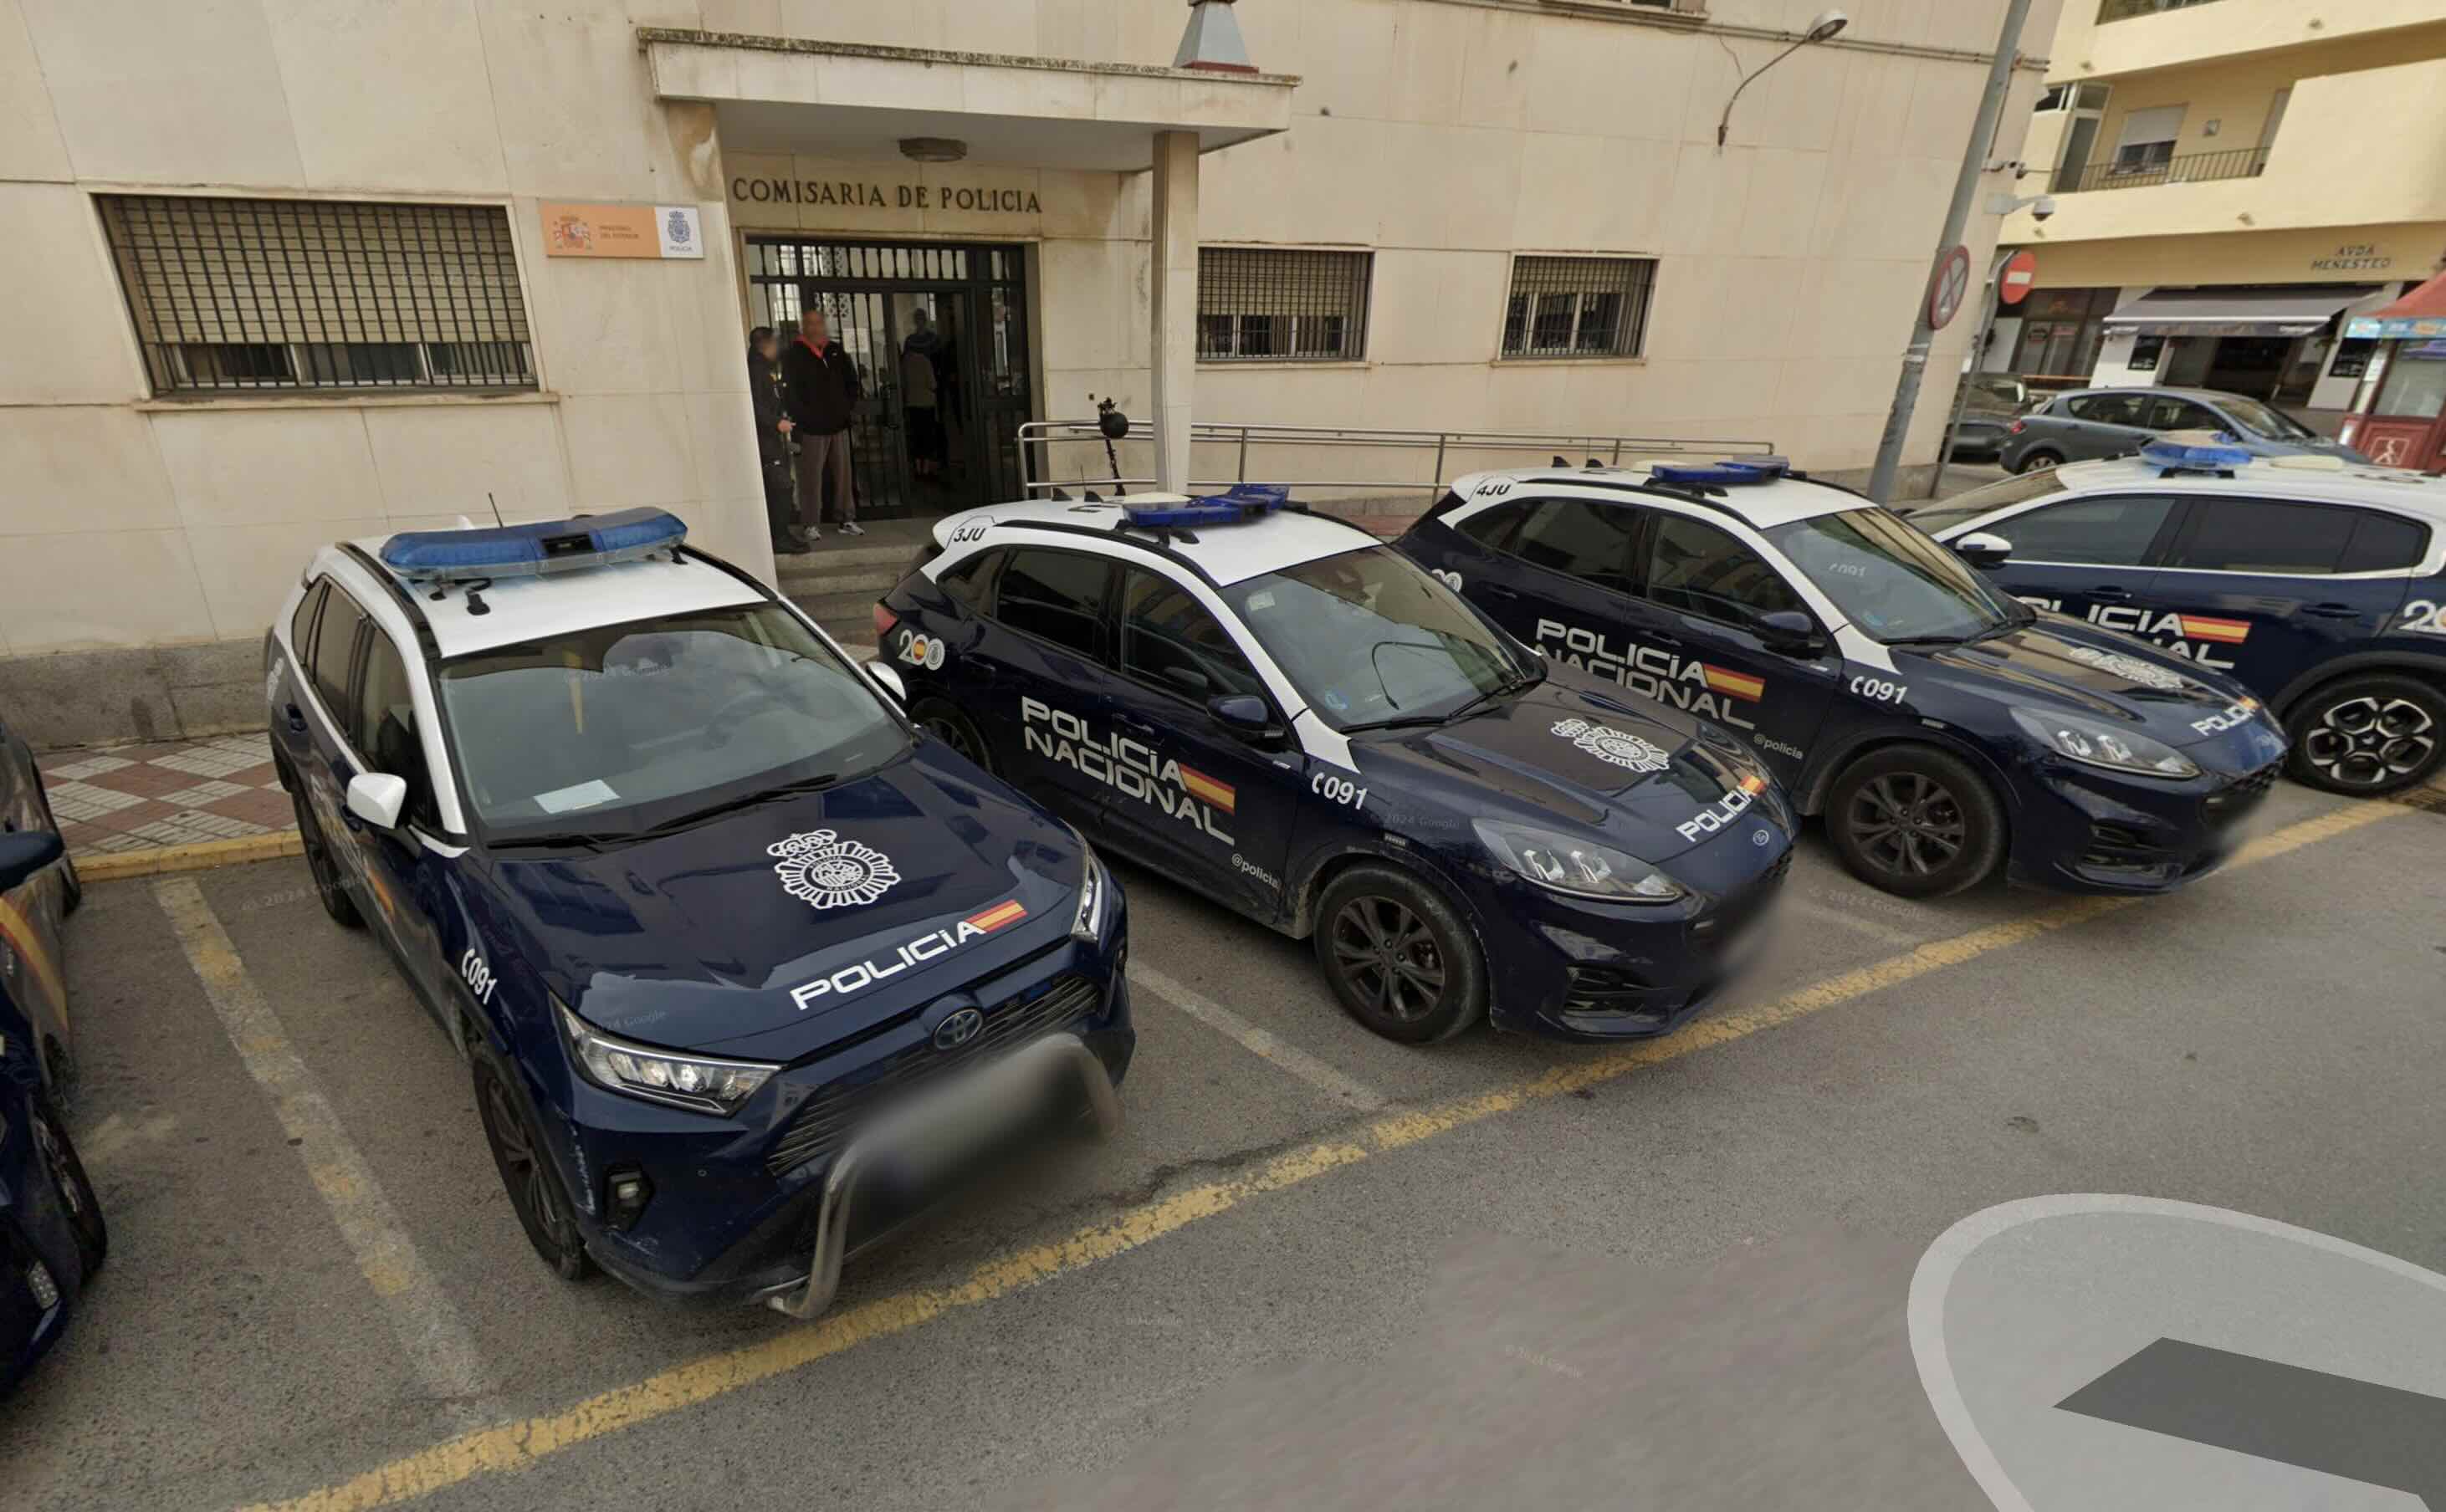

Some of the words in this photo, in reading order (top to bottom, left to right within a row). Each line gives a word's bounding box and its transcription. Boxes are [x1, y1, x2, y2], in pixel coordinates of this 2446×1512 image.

[732, 178, 886, 207] COMISARIA
[898, 184, 929, 209] DE
[941, 186, 1042, 213] POLICIA
[1476, 484, 1511, 496] 4JU
[954, 528, 986, 543] 3JU
[1753, 733, 1804, 759] @policia
[1025, 726, 1235, 846] NACIONAL
